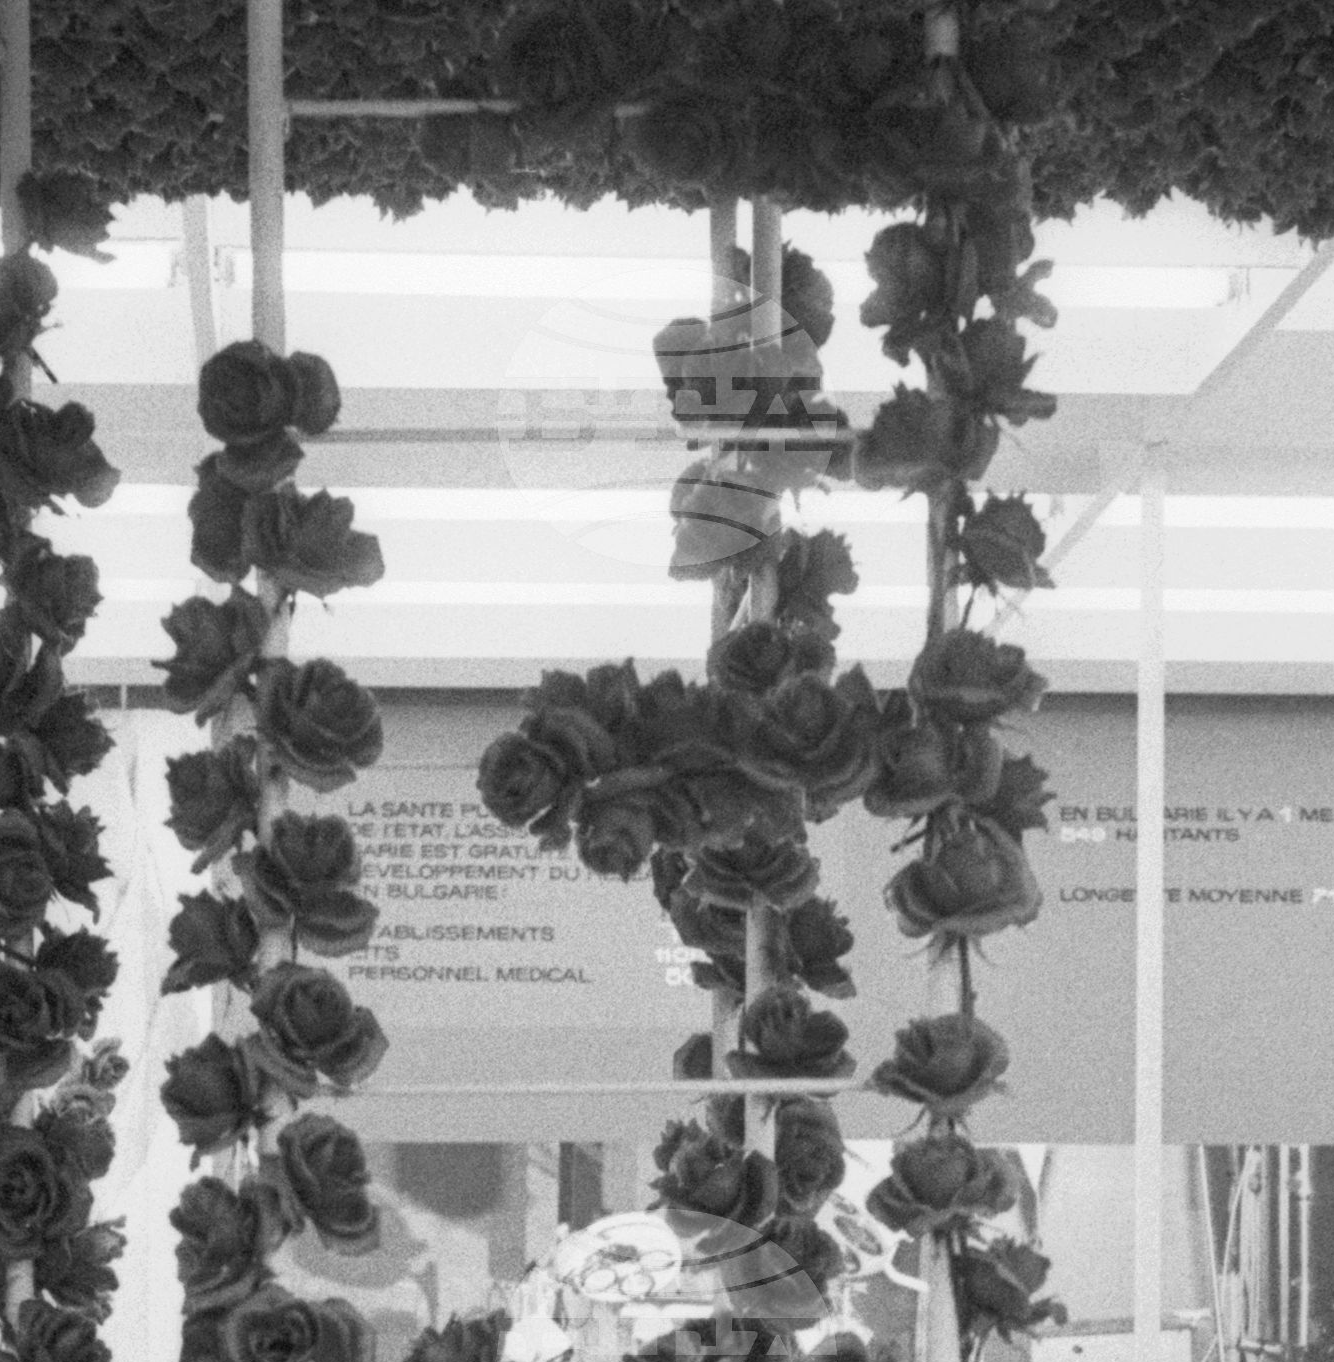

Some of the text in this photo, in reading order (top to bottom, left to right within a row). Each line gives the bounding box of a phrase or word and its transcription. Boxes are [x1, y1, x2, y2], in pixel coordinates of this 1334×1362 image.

[349, 802, 376, 818] LA
[382, 802, 454, 818] SANTE
[1060, 806, 1089, 822] EN
[1096, 806, 1208, 822] BULARIE
[1237, 806, 1253, 822] Y
[1256, 806, 1275, 822] A
[1279, 806, 1292, 823] 1
[358, 844, 413, 858] ARIE
[421, 844, 460, 859] EST
[363, 864, 539, 880] EVELOPPEMENT
[1060, 888, 1181, 903] LONGEE
[1188, 888, 1303, 903] MOYENNE
[376, 924, 554, 942] ABLISSEMENTS
[349, 965, 594, 984] PERSONNEL MEDICAL
